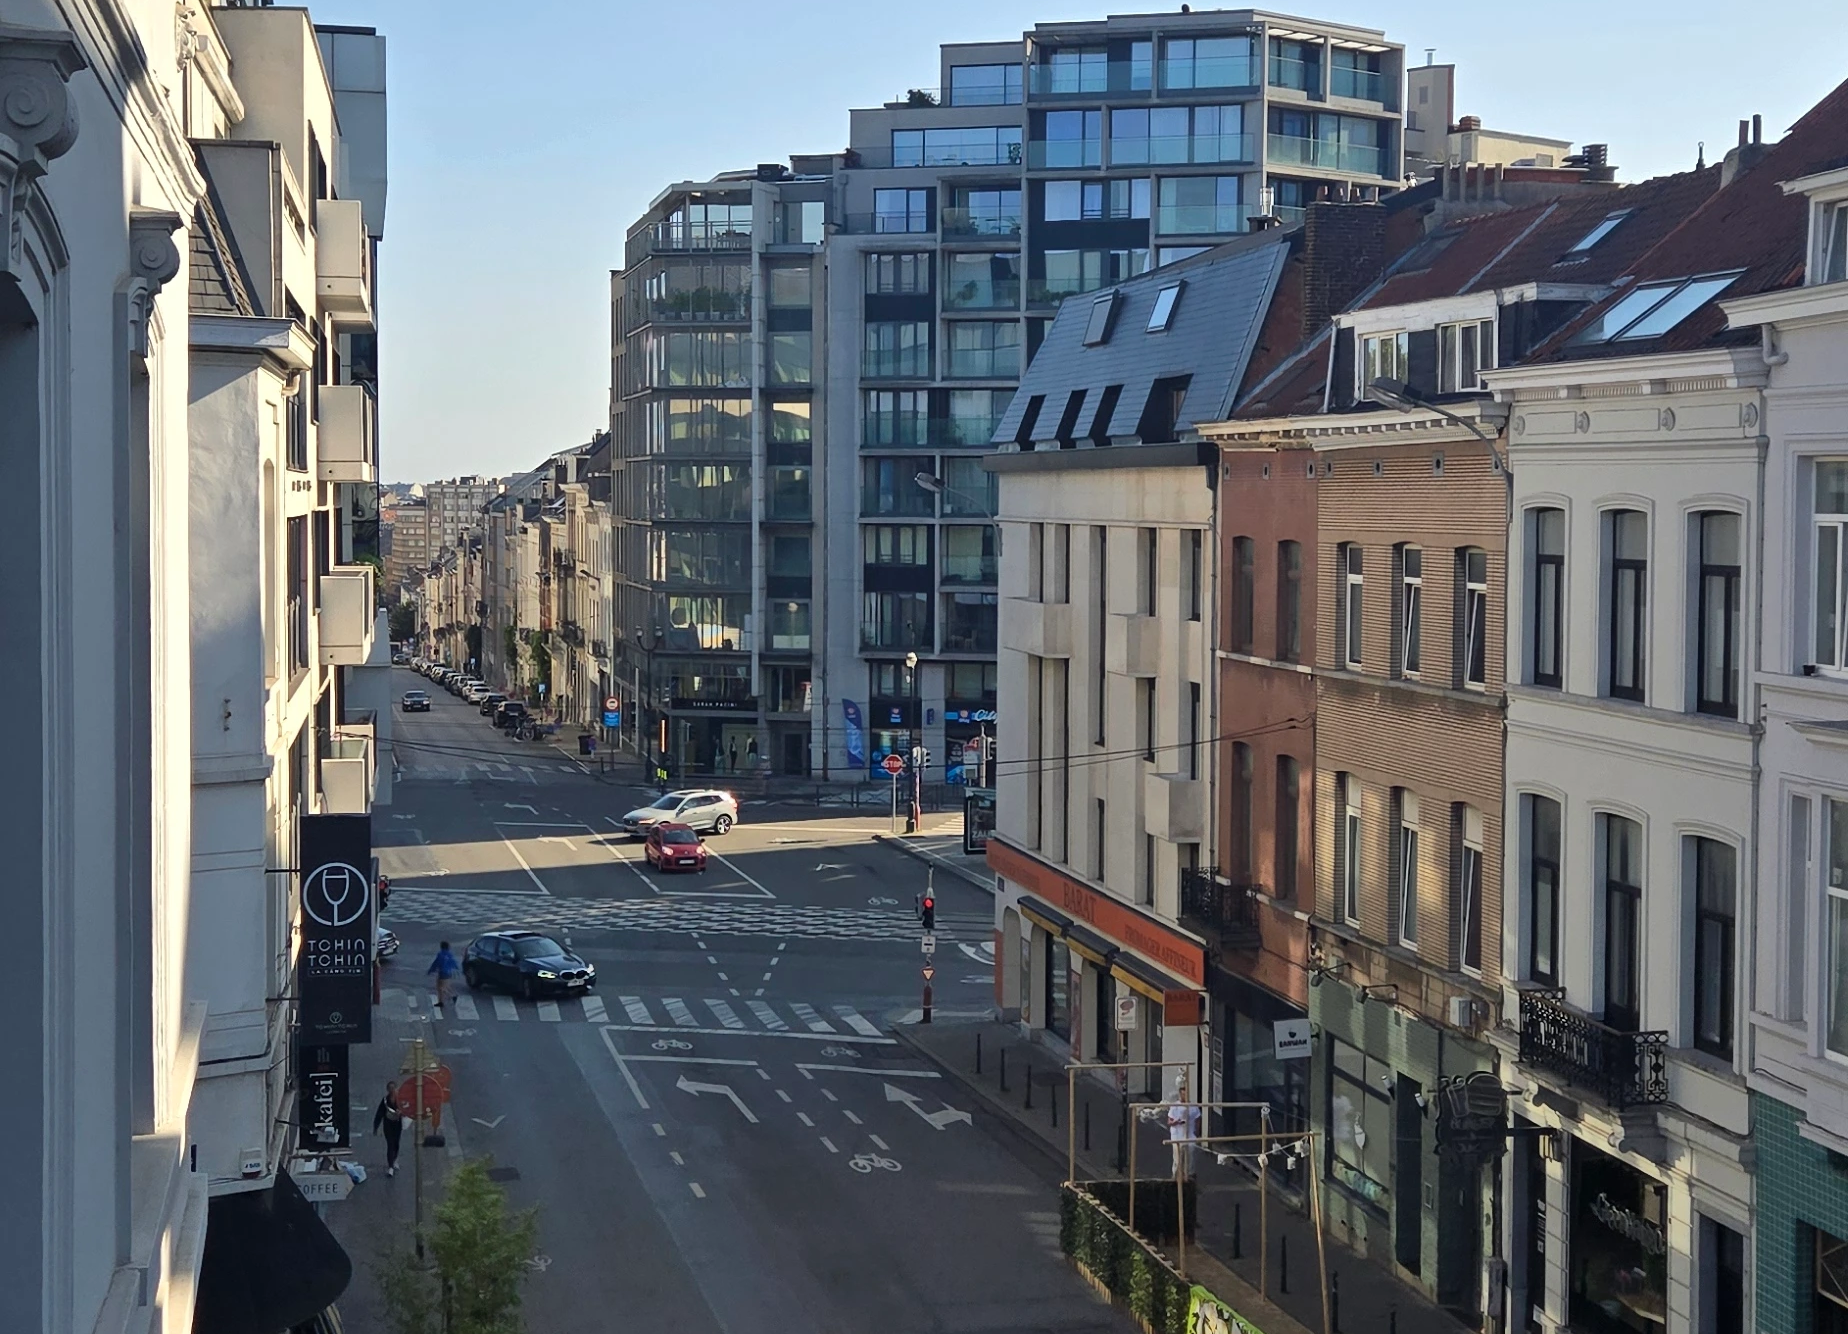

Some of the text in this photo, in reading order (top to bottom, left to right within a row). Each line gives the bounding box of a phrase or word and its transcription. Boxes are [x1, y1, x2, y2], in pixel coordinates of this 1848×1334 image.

[1064, 881, 1096, 924] BARAT
[307, 938, 365, 952] TCHIN
[307, 953, 365, 967] TCHIN
